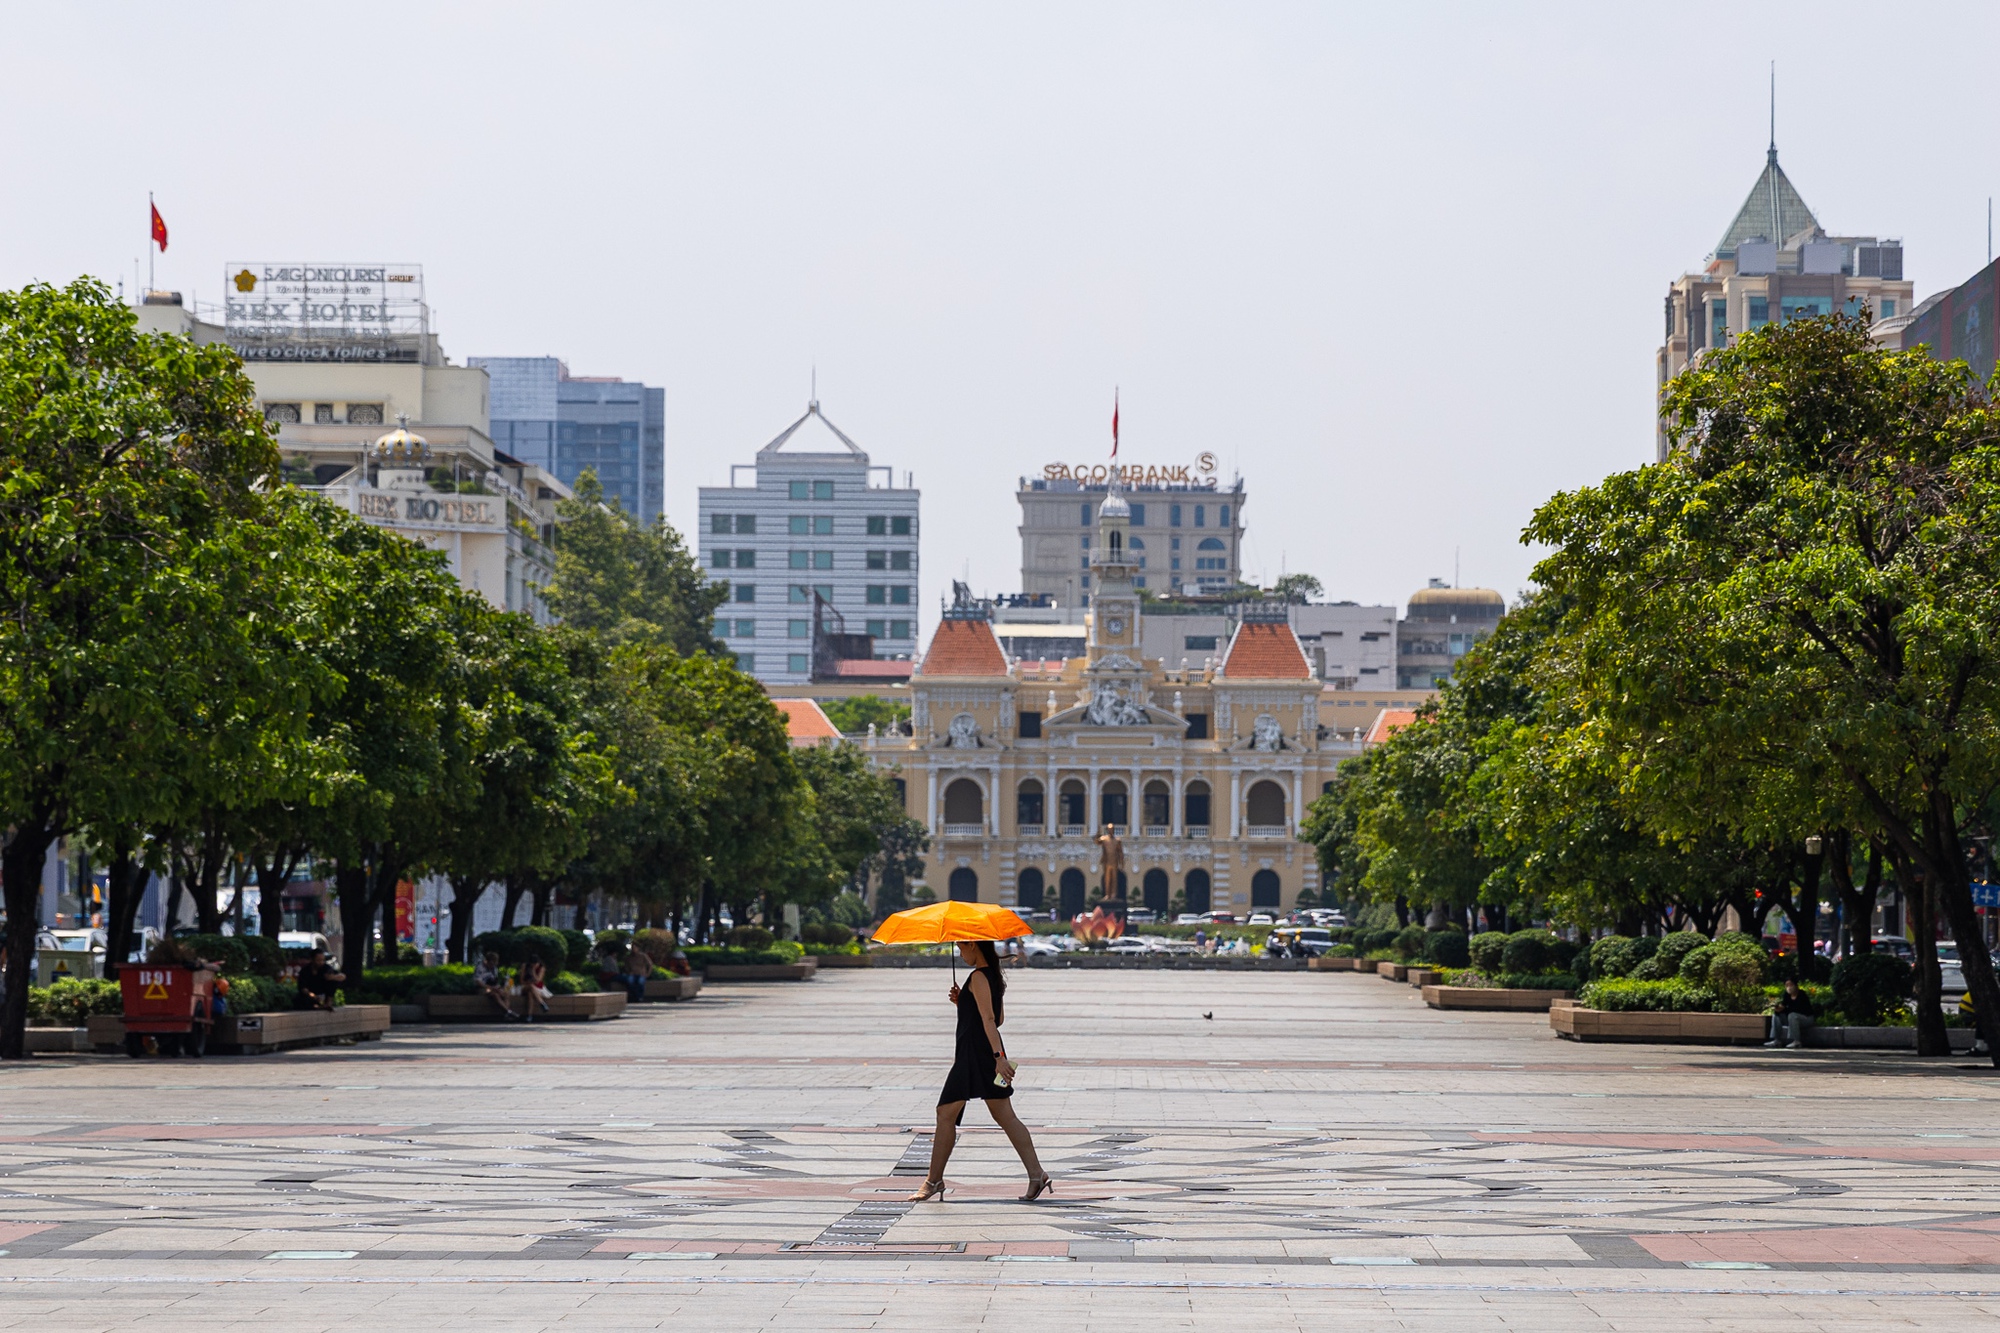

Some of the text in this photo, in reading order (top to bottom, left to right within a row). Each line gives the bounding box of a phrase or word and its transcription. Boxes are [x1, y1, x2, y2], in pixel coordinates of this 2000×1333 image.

[264, 267, 385, 282] SAIGONTOURIST
[226, 303, 395, 322] REX HOTEL
[1043, 464, 1191, 482] SACOMBANK
[358, 493, 496, 525] REX HOTEL
[139, 970, 173, 986] B91
